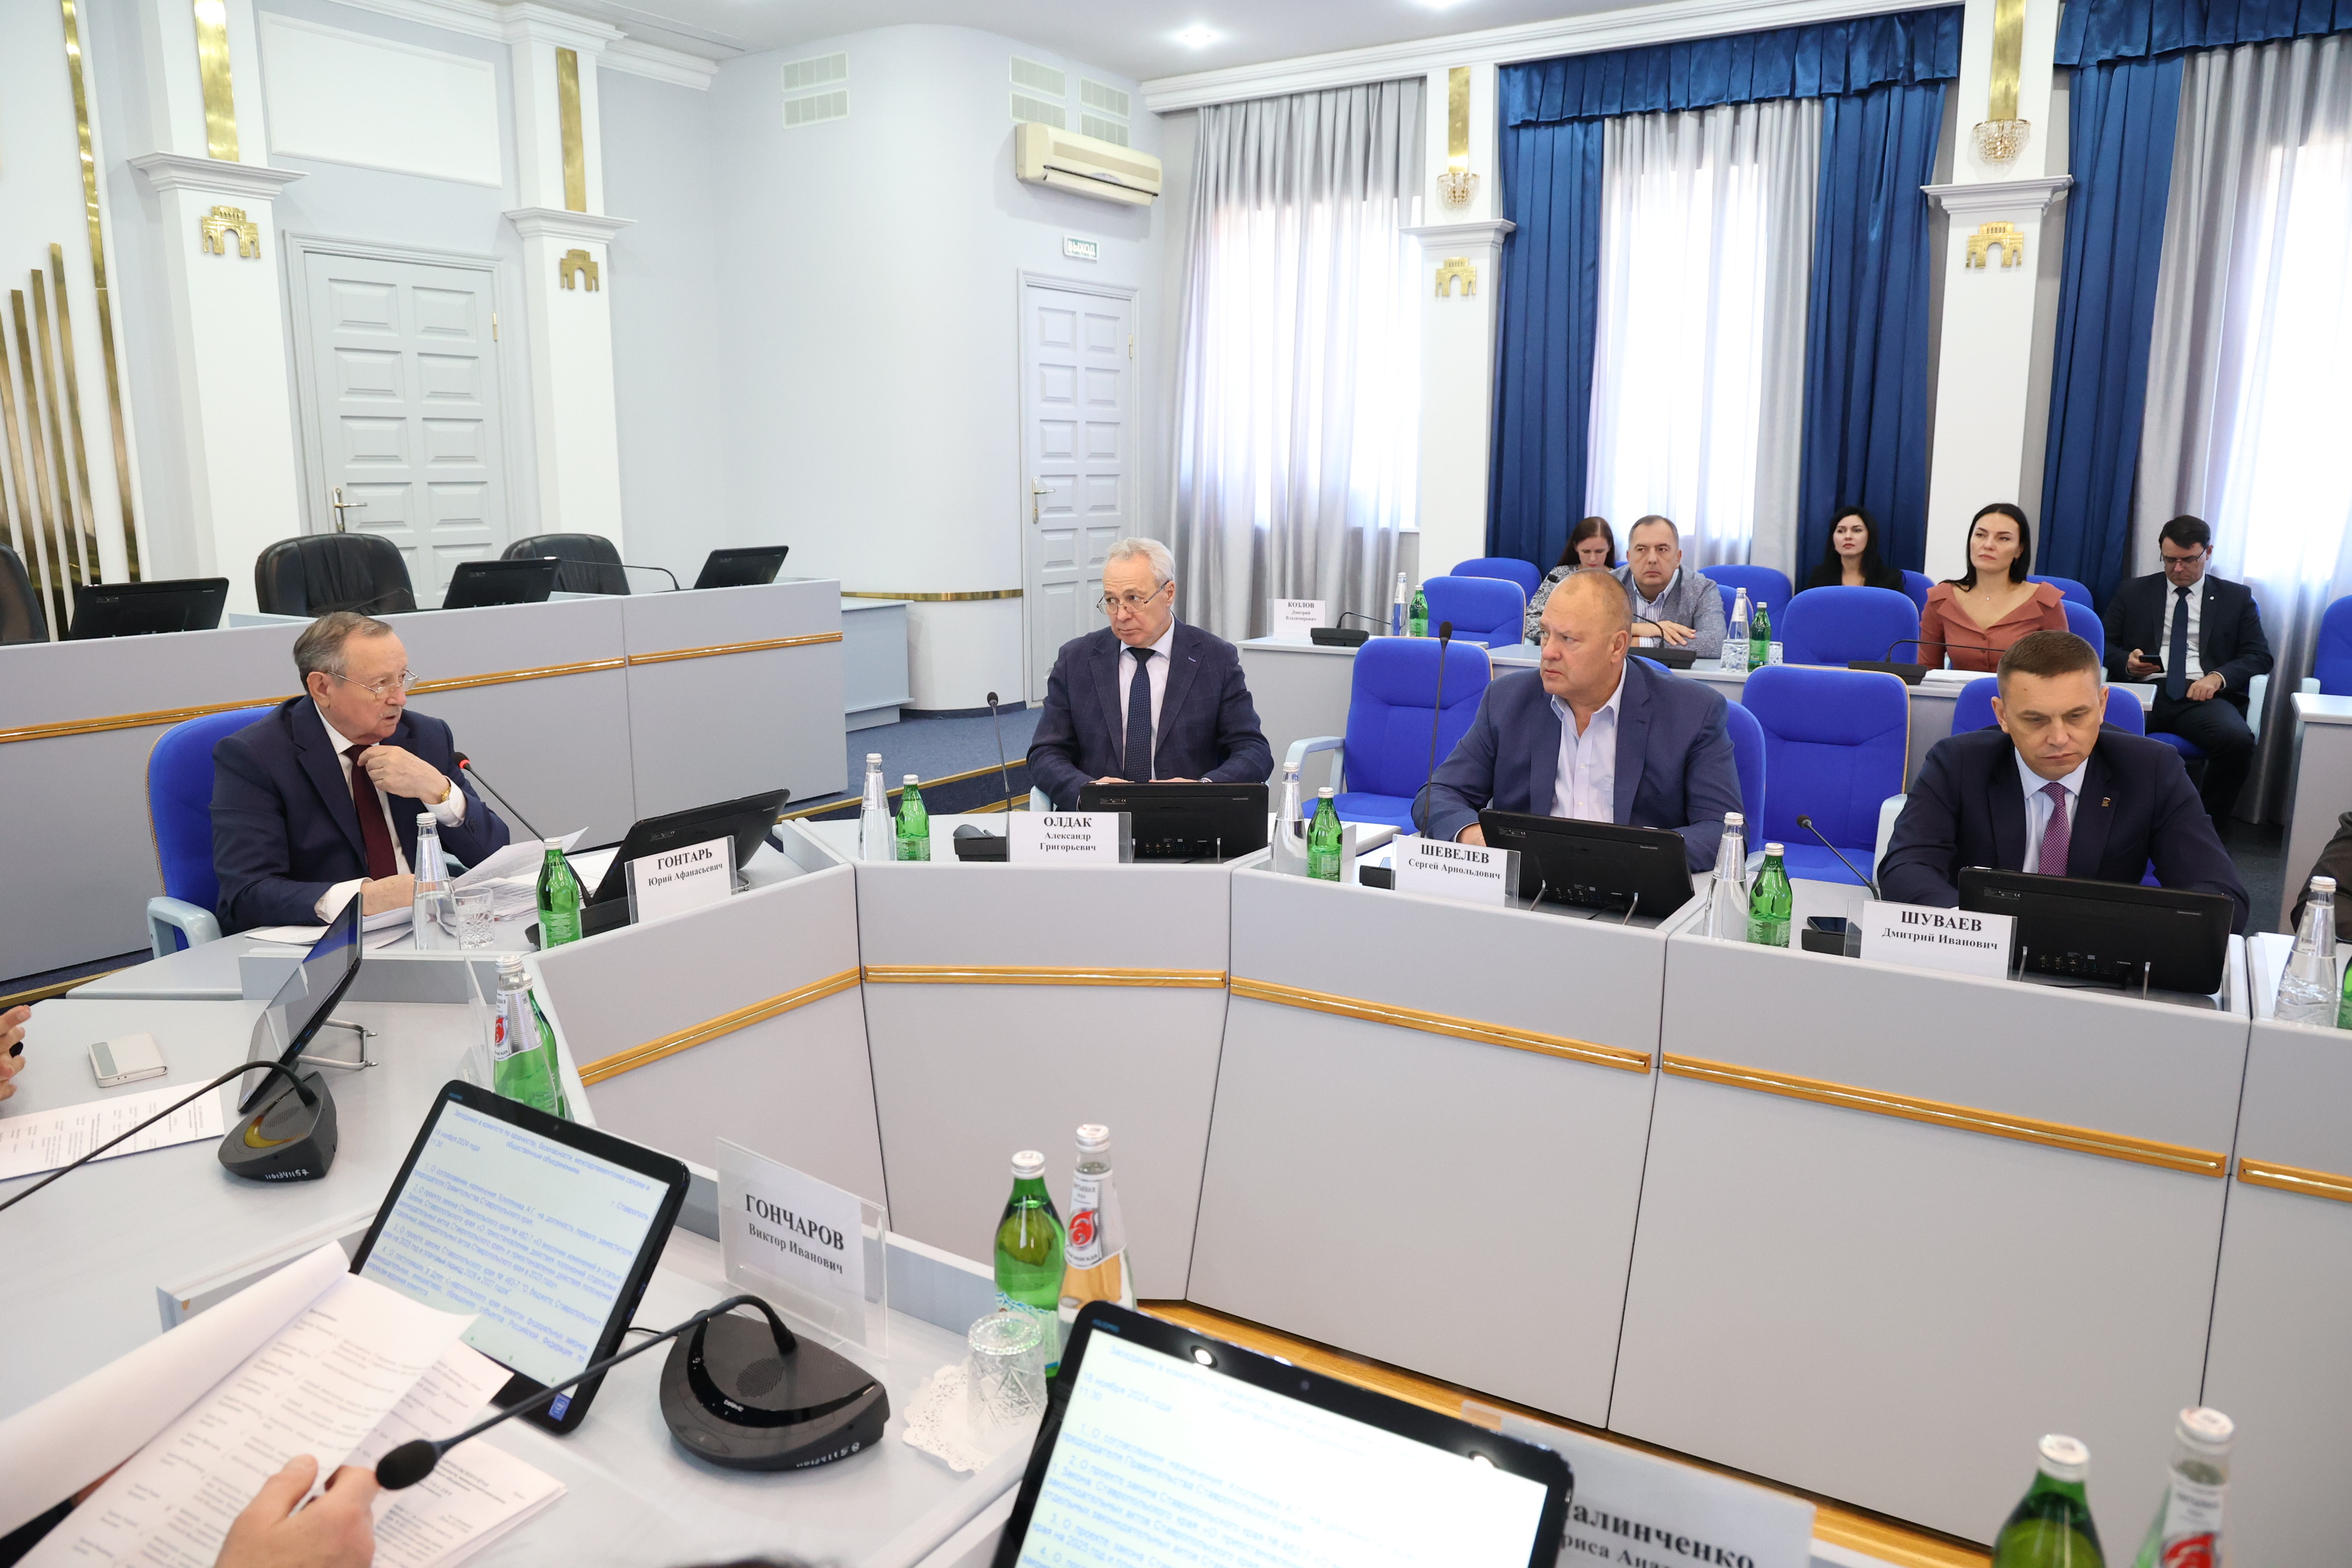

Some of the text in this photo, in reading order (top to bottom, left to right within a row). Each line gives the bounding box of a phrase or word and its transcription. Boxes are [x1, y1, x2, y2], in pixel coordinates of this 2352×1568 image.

[1068, 240, 1095, 256] ВЫХОД
[1044, 816, 1092, 828] ОЛДАК
[1040, 842, 1096, 852] Григорьевич
[1044, 832, 1091, 841] Александр
[658, 848, 712, 870] ГОНТАРЬ
[1420, 844, 1489, 863] ШЕВЕЛЕВ
[648, 863, 723, 887] Юрий Афанасьевич
[1408, 858, 1500, 879] Сергей Арнольдович
[1901, 910, 1982, 932] ШУВАЕВ
[1882, 928, 1998, 950] Дмитрий Иванович
[745, 1193, 844, 1250] ГОНЧАРОВ
[749, 1222, 843, 1275] Виктор Иванович
[1561, 1533, 1610, 1559] риса
[1569, 1504, 1755, 1568] алинченко
